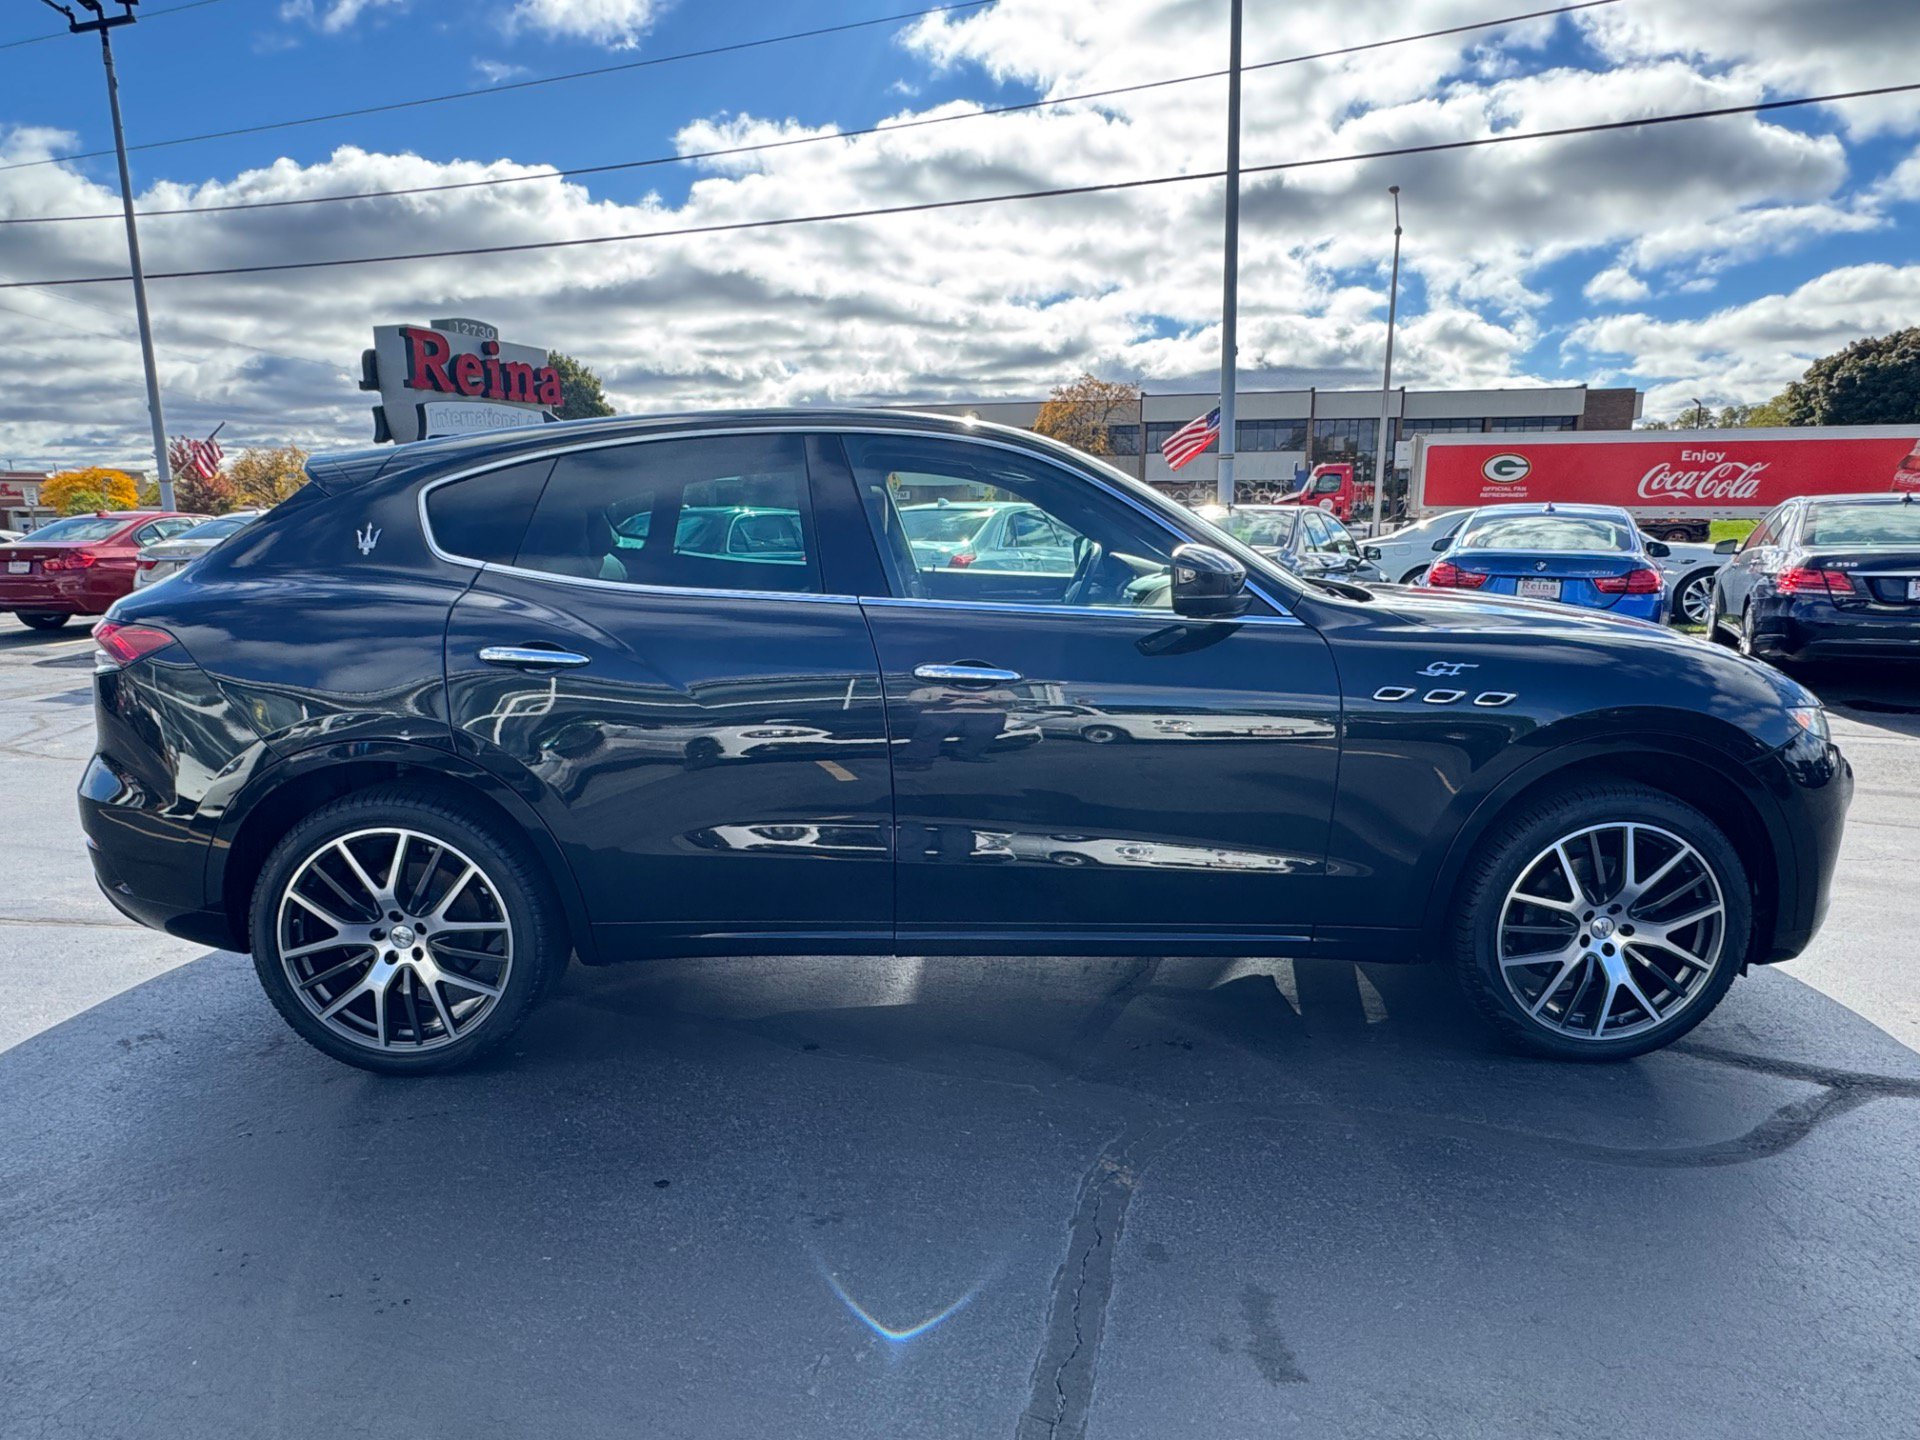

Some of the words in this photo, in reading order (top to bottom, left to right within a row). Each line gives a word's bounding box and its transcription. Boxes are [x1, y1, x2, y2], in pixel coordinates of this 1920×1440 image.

[454, 321, 495, 339] 12730
[405, 327, 564, 407] Reina
[429, 407, 521, 429] International
[1681, 449, 1726, 463] Enjoy
[1637, 461, 1771, 499] Coca-Cola
[1522, 580, 1557, 591] Reina
